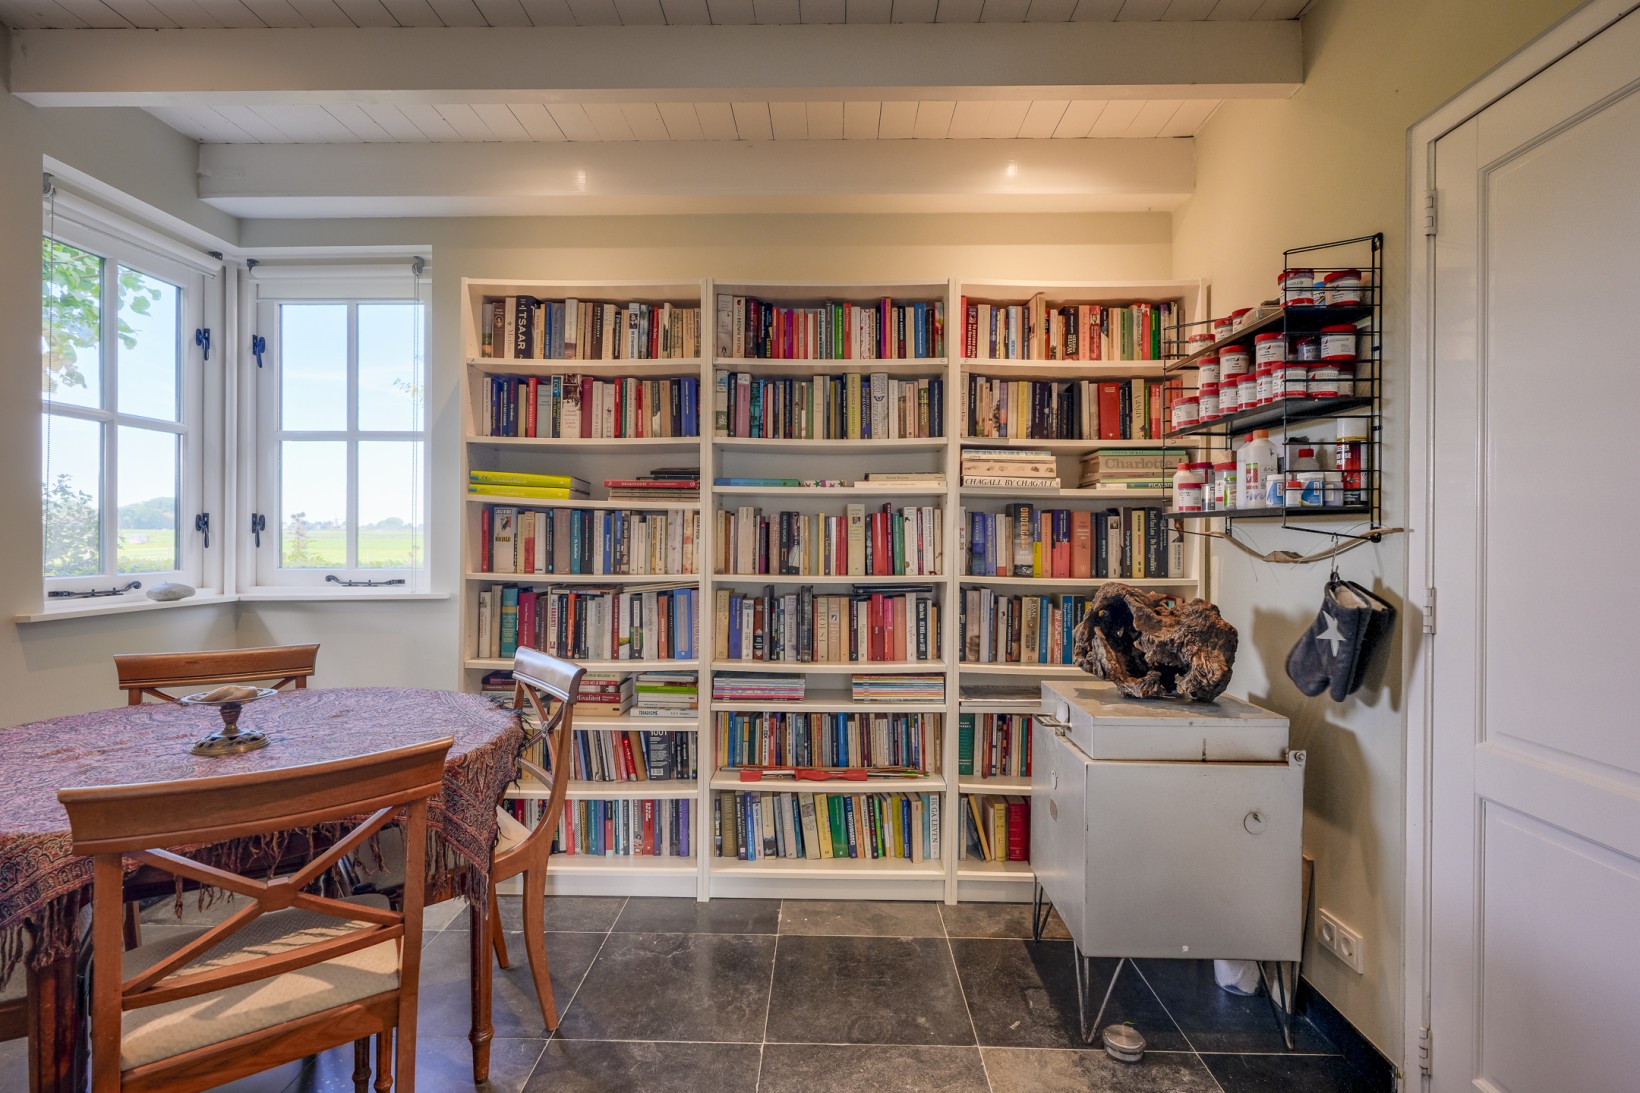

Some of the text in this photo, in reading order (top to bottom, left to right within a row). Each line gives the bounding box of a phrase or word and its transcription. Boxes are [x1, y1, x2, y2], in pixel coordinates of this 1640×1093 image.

[518, 312, 526, 349] TSAAR
[1105, 458, 1172, 469] Charlotte
[1020, 508, 1029, 549] ONDERGANG
[931, 807, 938, 817] GA
